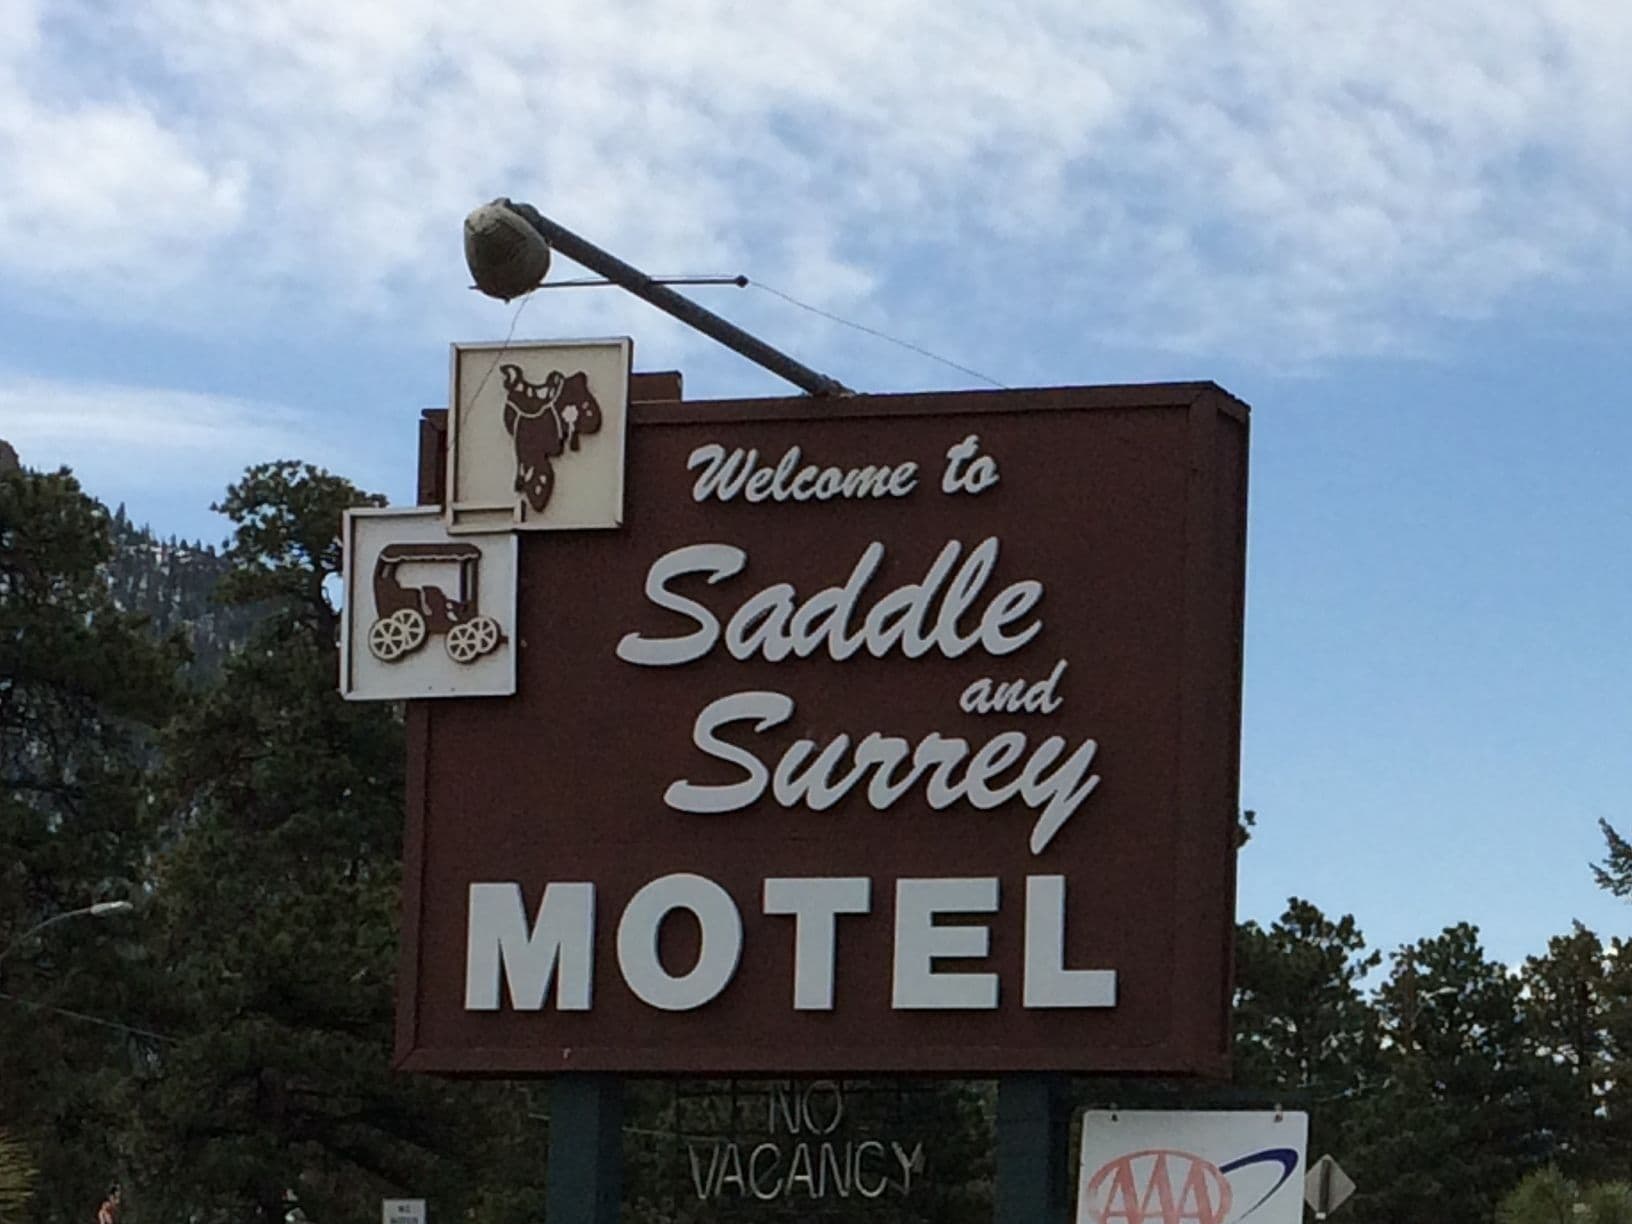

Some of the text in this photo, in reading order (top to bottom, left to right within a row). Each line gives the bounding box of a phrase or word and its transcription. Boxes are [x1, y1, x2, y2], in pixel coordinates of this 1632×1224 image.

[688, 434, 997, 503] Welcome to
[616, 537, 1042, 666] Saddle
[960, 660, 1068, 715] and
[664, 691, 1100, 854] Surrey
[464, 873, 1117, 1011] MOTEL
[768, 1079, 842, 1135] NO
[688, 1140, 924, 1200] VACANCY
